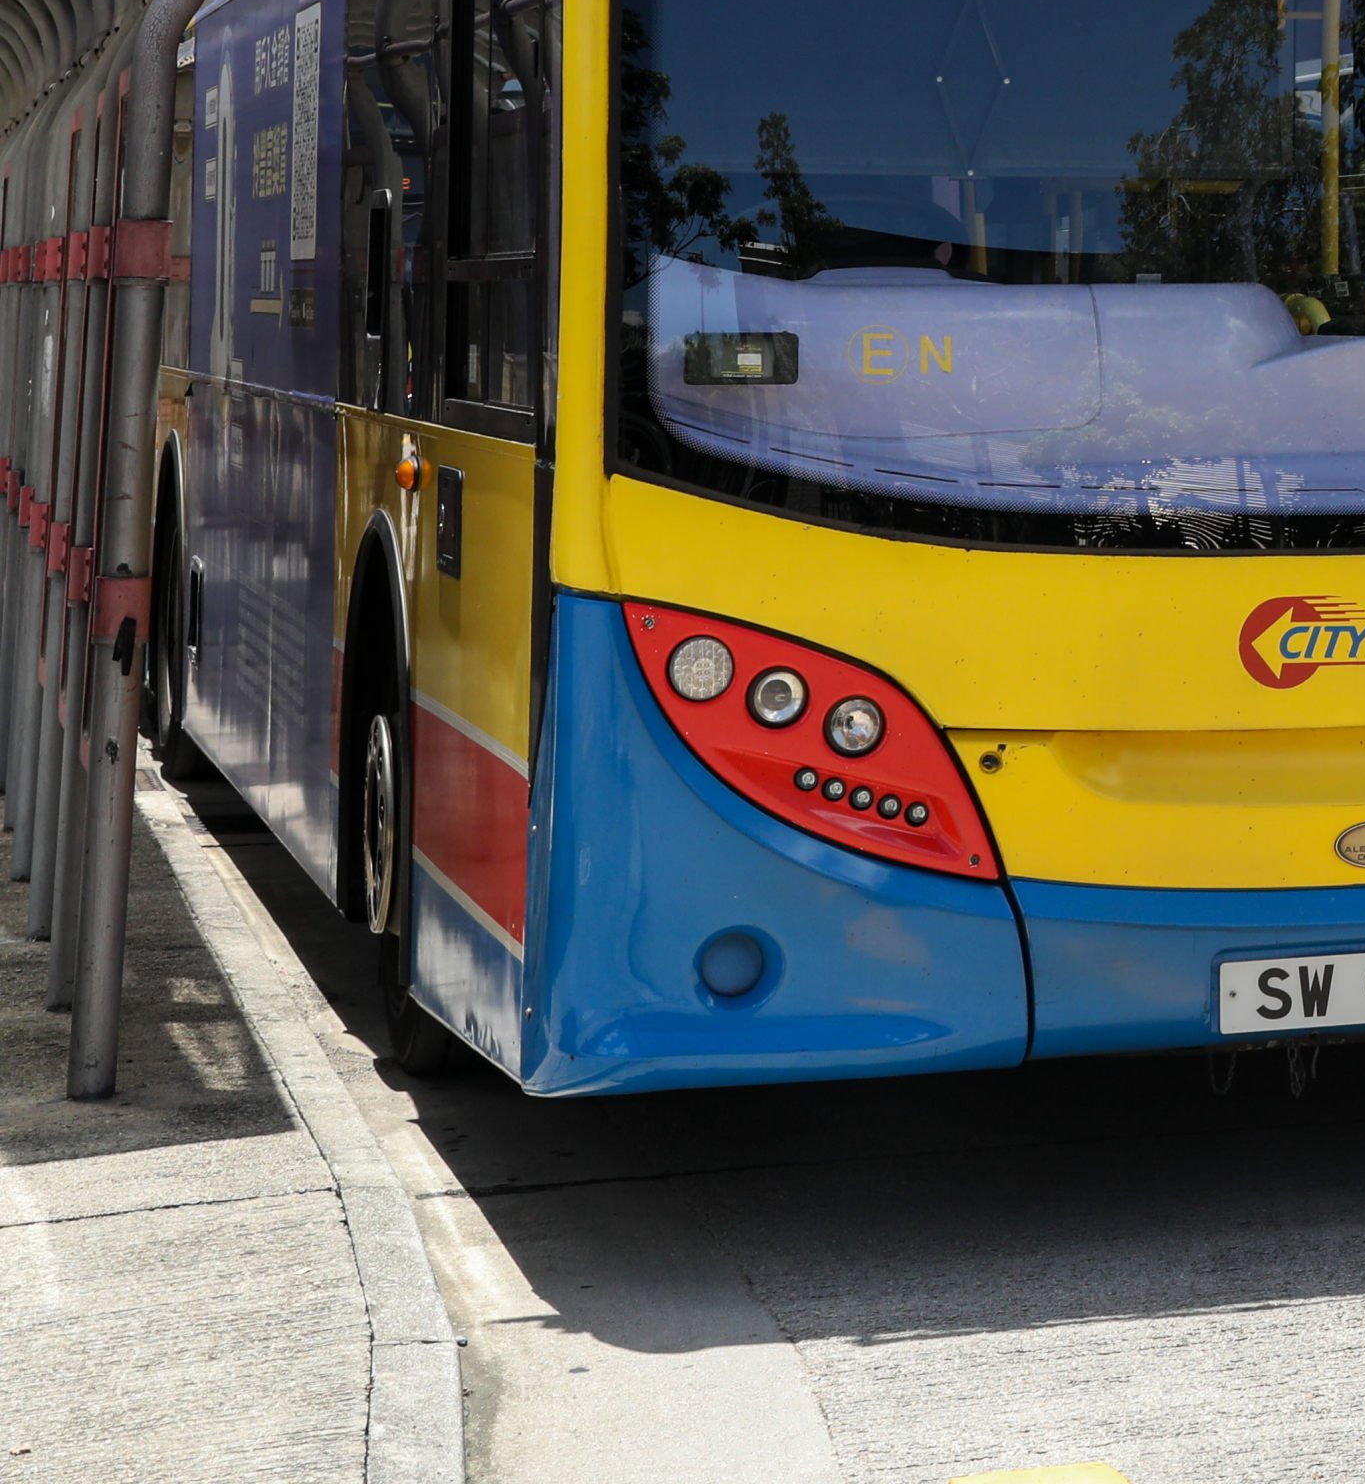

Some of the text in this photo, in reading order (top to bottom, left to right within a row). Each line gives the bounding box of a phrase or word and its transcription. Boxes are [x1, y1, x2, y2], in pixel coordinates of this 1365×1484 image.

[862, 332, 953, 375] E N
[1256, 964, 1335, 1019] SW
